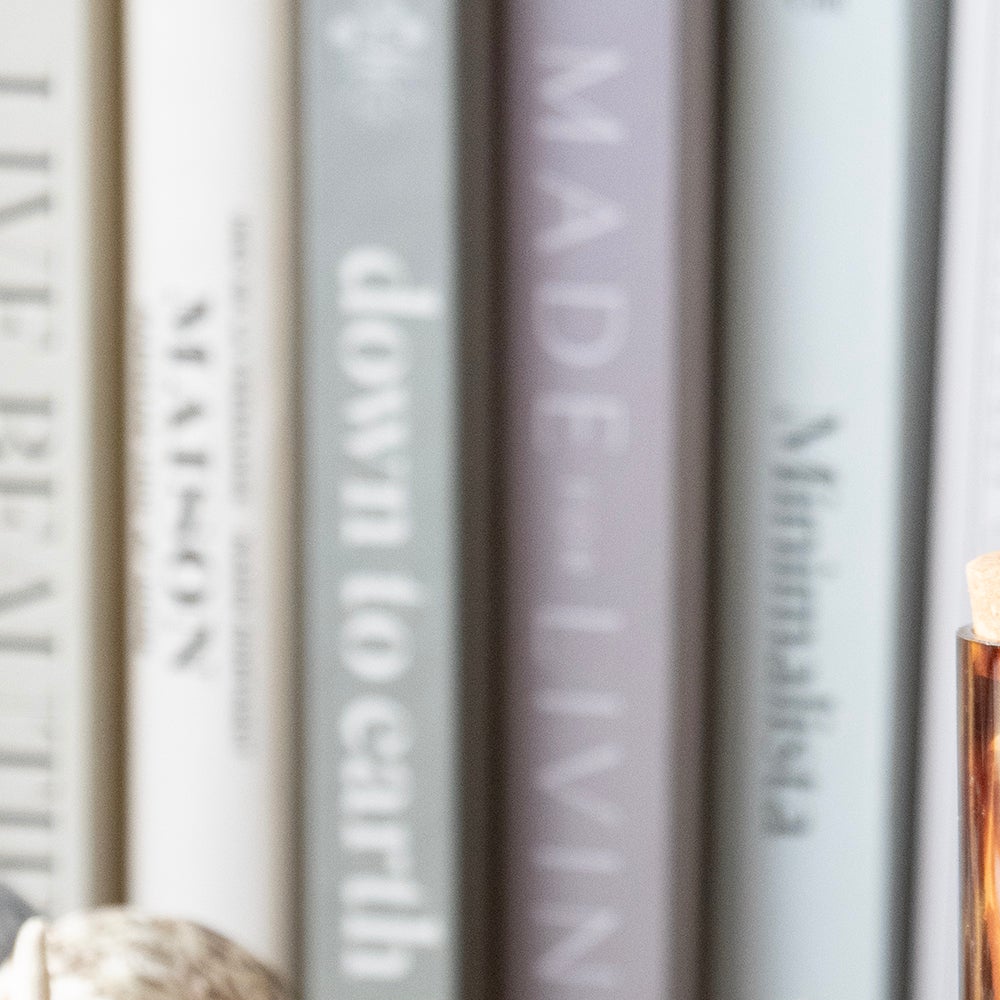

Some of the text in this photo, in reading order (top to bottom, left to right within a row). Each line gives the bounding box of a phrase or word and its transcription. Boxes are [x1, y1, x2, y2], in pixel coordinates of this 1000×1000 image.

[533, 46, 630, 455] MADE
[336, 246, 443, 979] down to earth
